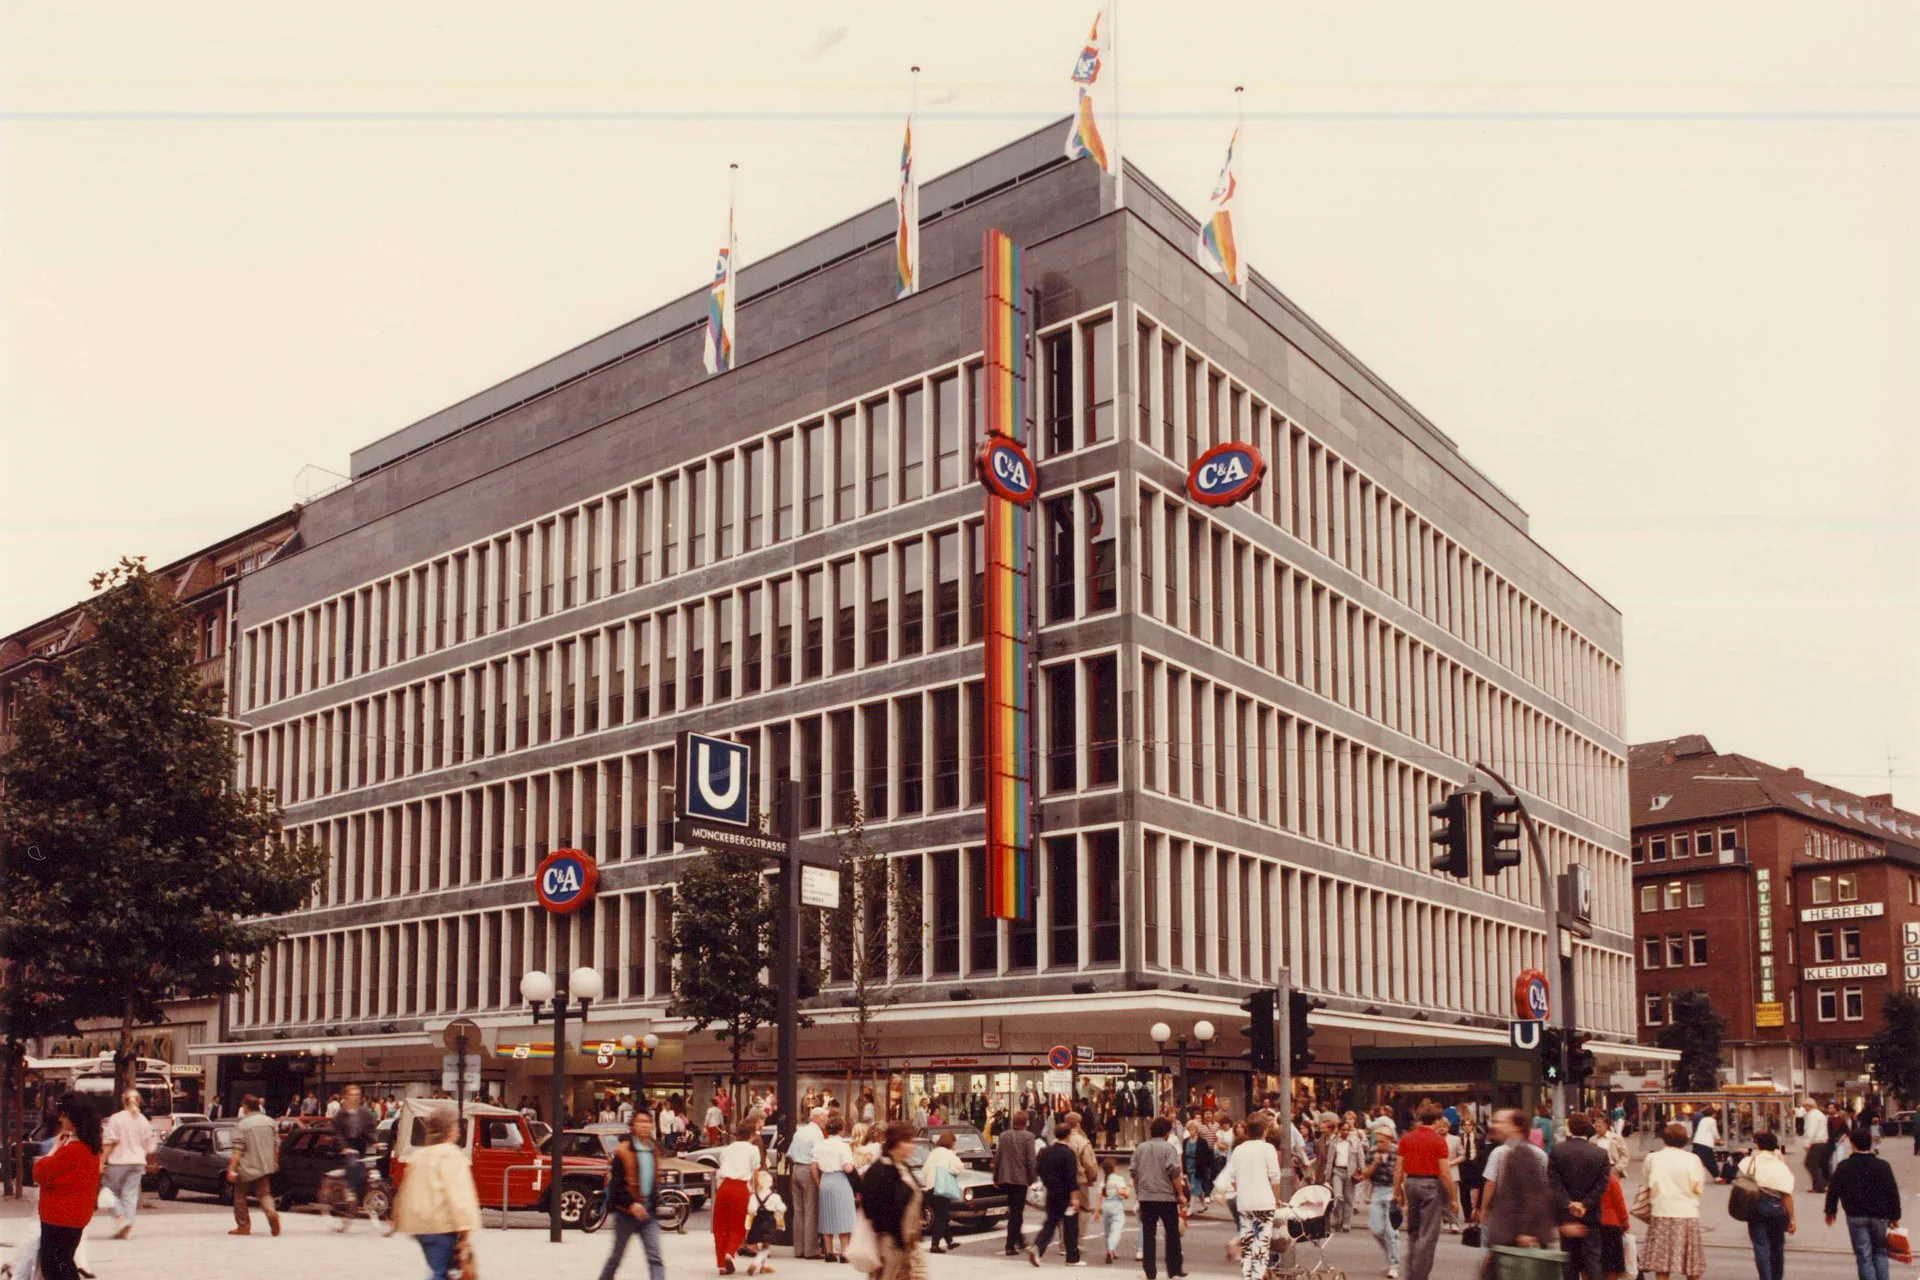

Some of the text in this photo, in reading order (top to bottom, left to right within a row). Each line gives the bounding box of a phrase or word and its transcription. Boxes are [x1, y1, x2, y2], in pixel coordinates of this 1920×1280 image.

[993, 450, 1029, 489] C&A
[1198, 456, 1248, 489] C&A
[698, 743, 741, 810] U
[691, 828, 787, 852] MÖNCKEBERGSTRASSE
[542, 865, 581, 895] C&A
[1810, 905, 1873, 920] HERREN
[1756, 869, 1775, 1002] HOLSTEN BIER
[1807, 964, 1884, 979] KLEIDUNG
[1514, 1023, 1539, 1050] U
